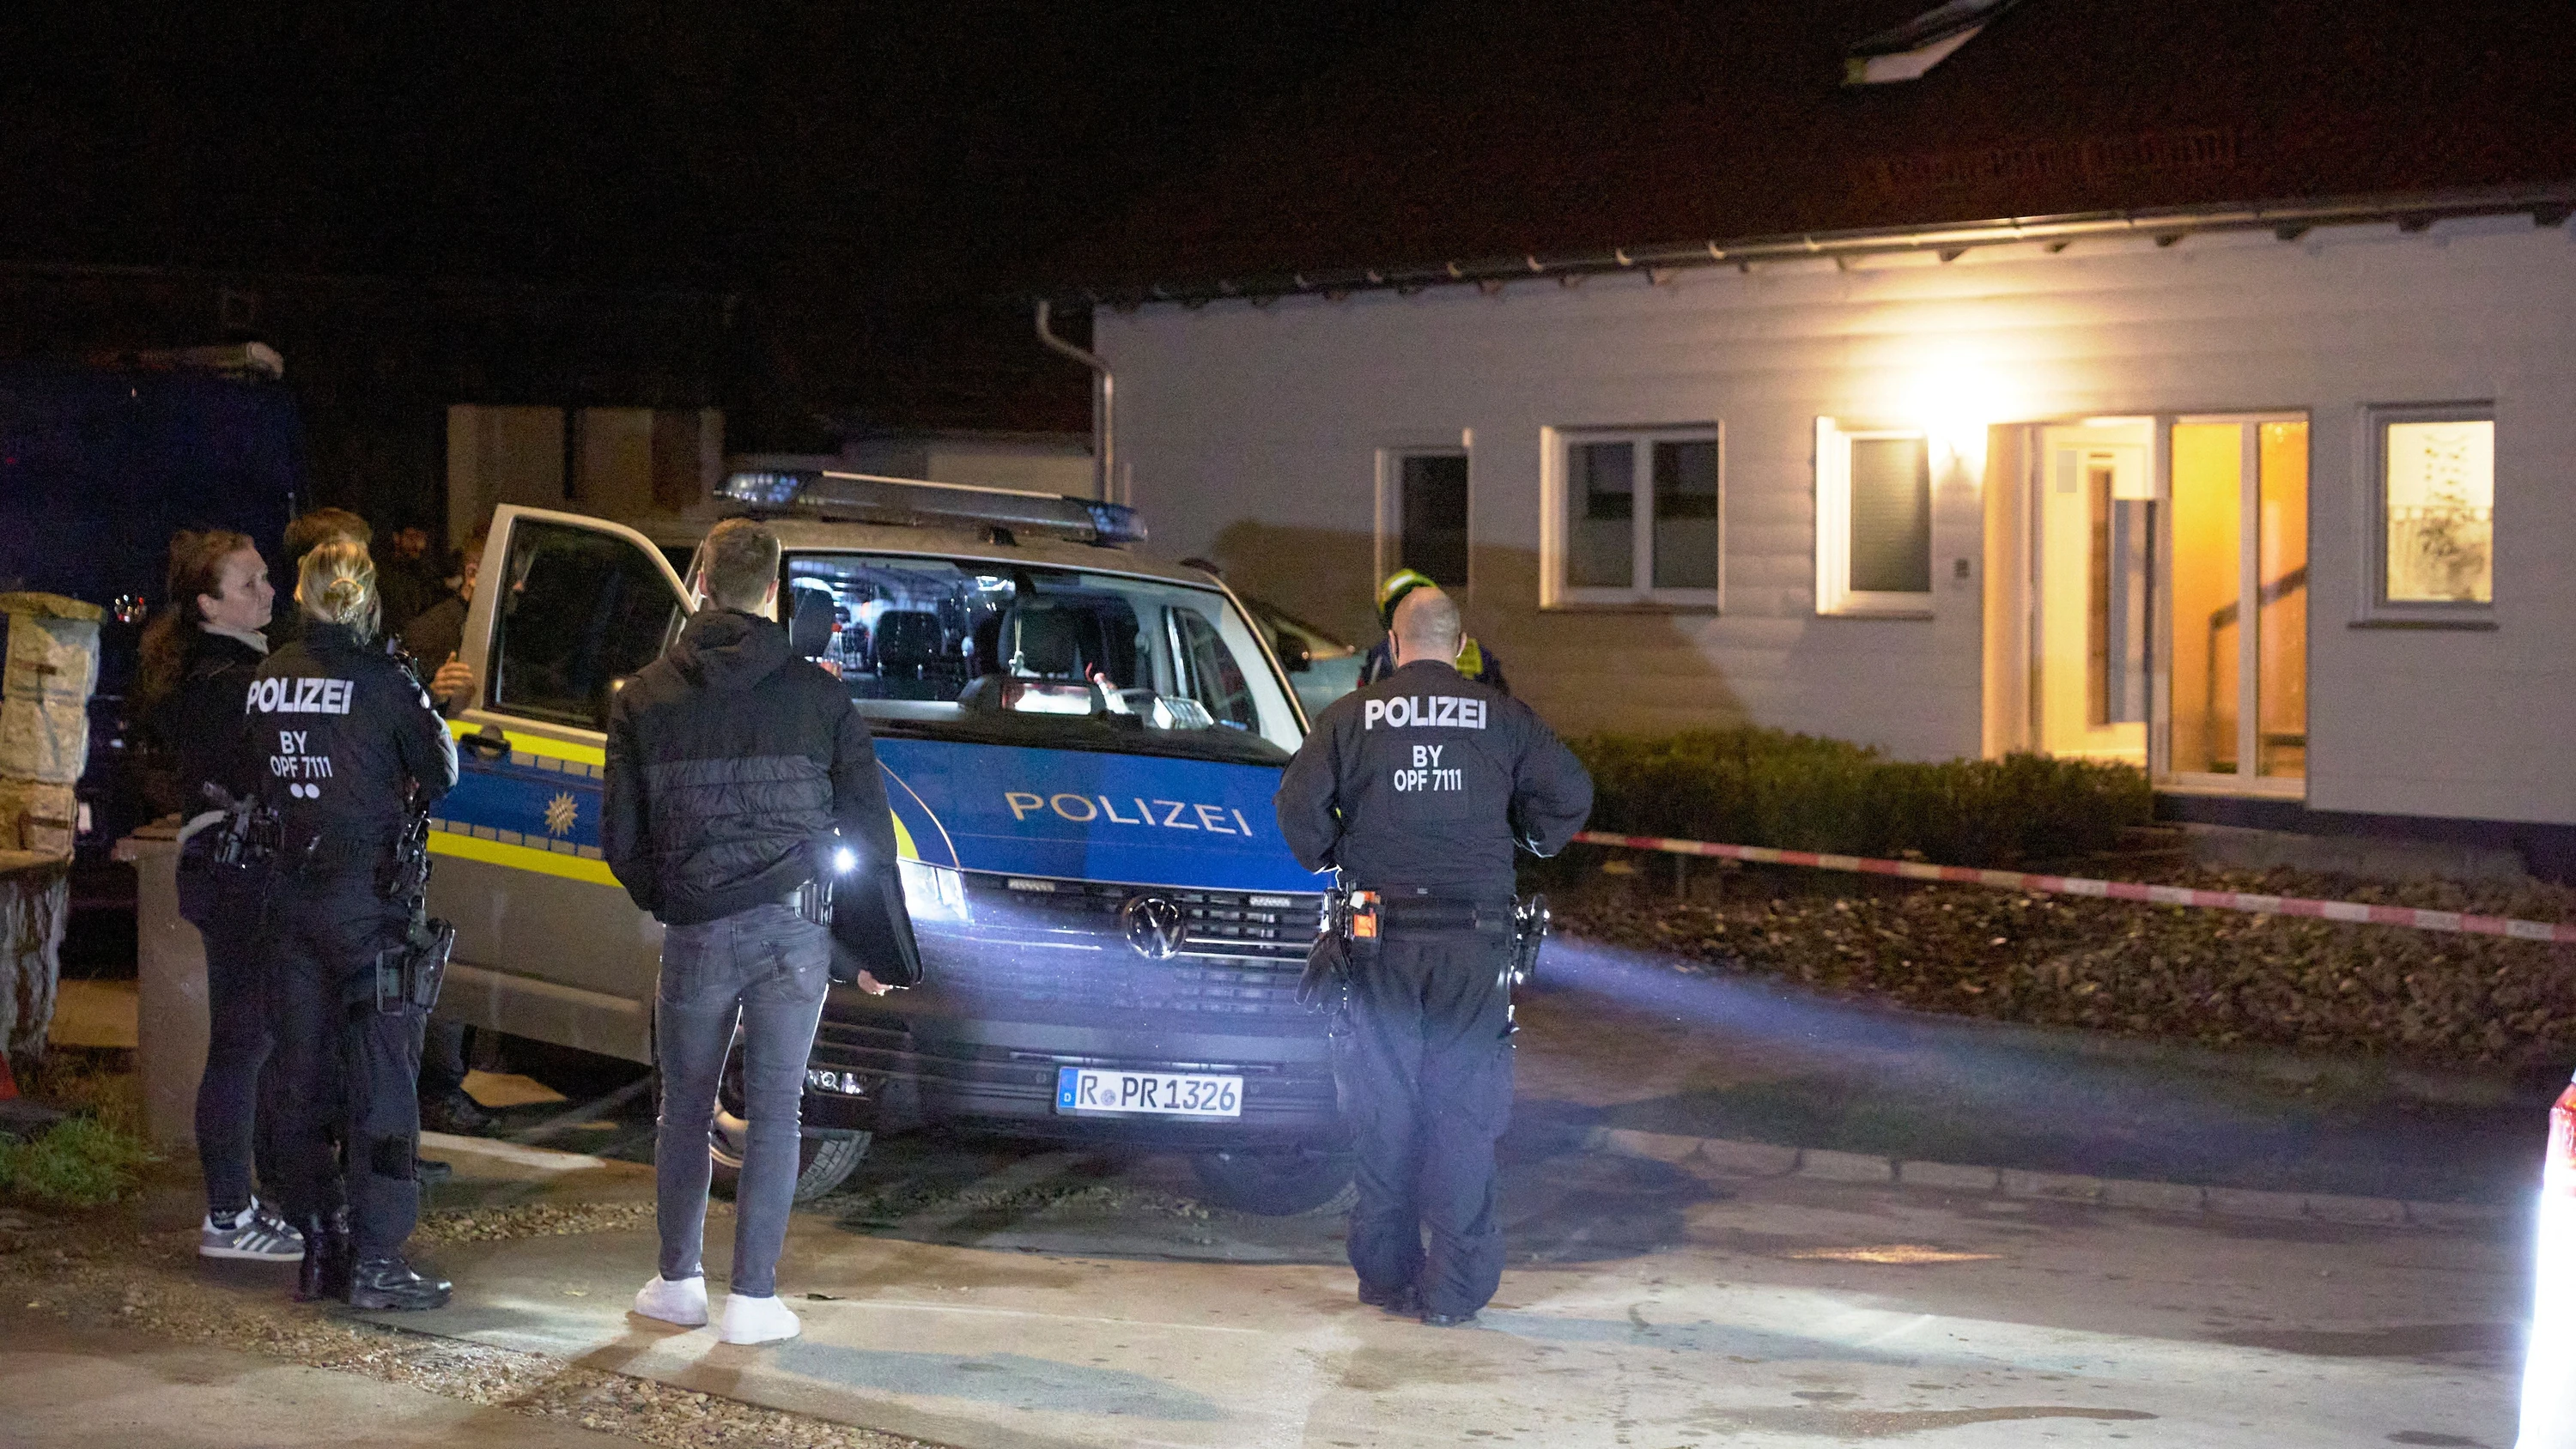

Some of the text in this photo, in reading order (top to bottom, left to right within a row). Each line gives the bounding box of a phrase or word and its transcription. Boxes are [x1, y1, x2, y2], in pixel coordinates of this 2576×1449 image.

[246, 677, 355, 715] POLIZEI
[1364, 695, 1487, 730] POLIZEI
[280, 731, 307, 755] BY
[270, 755, 333, 779] OPF 7111
[1413, 745, 1443, 767] BY
[1394, 768, 1461, 791] OPF 7111
[1004, 791, 1253, 837] POLIZEI
[1063, 1092, 1072, 1103] D
[1078, 1075, 1098, 1106] R
